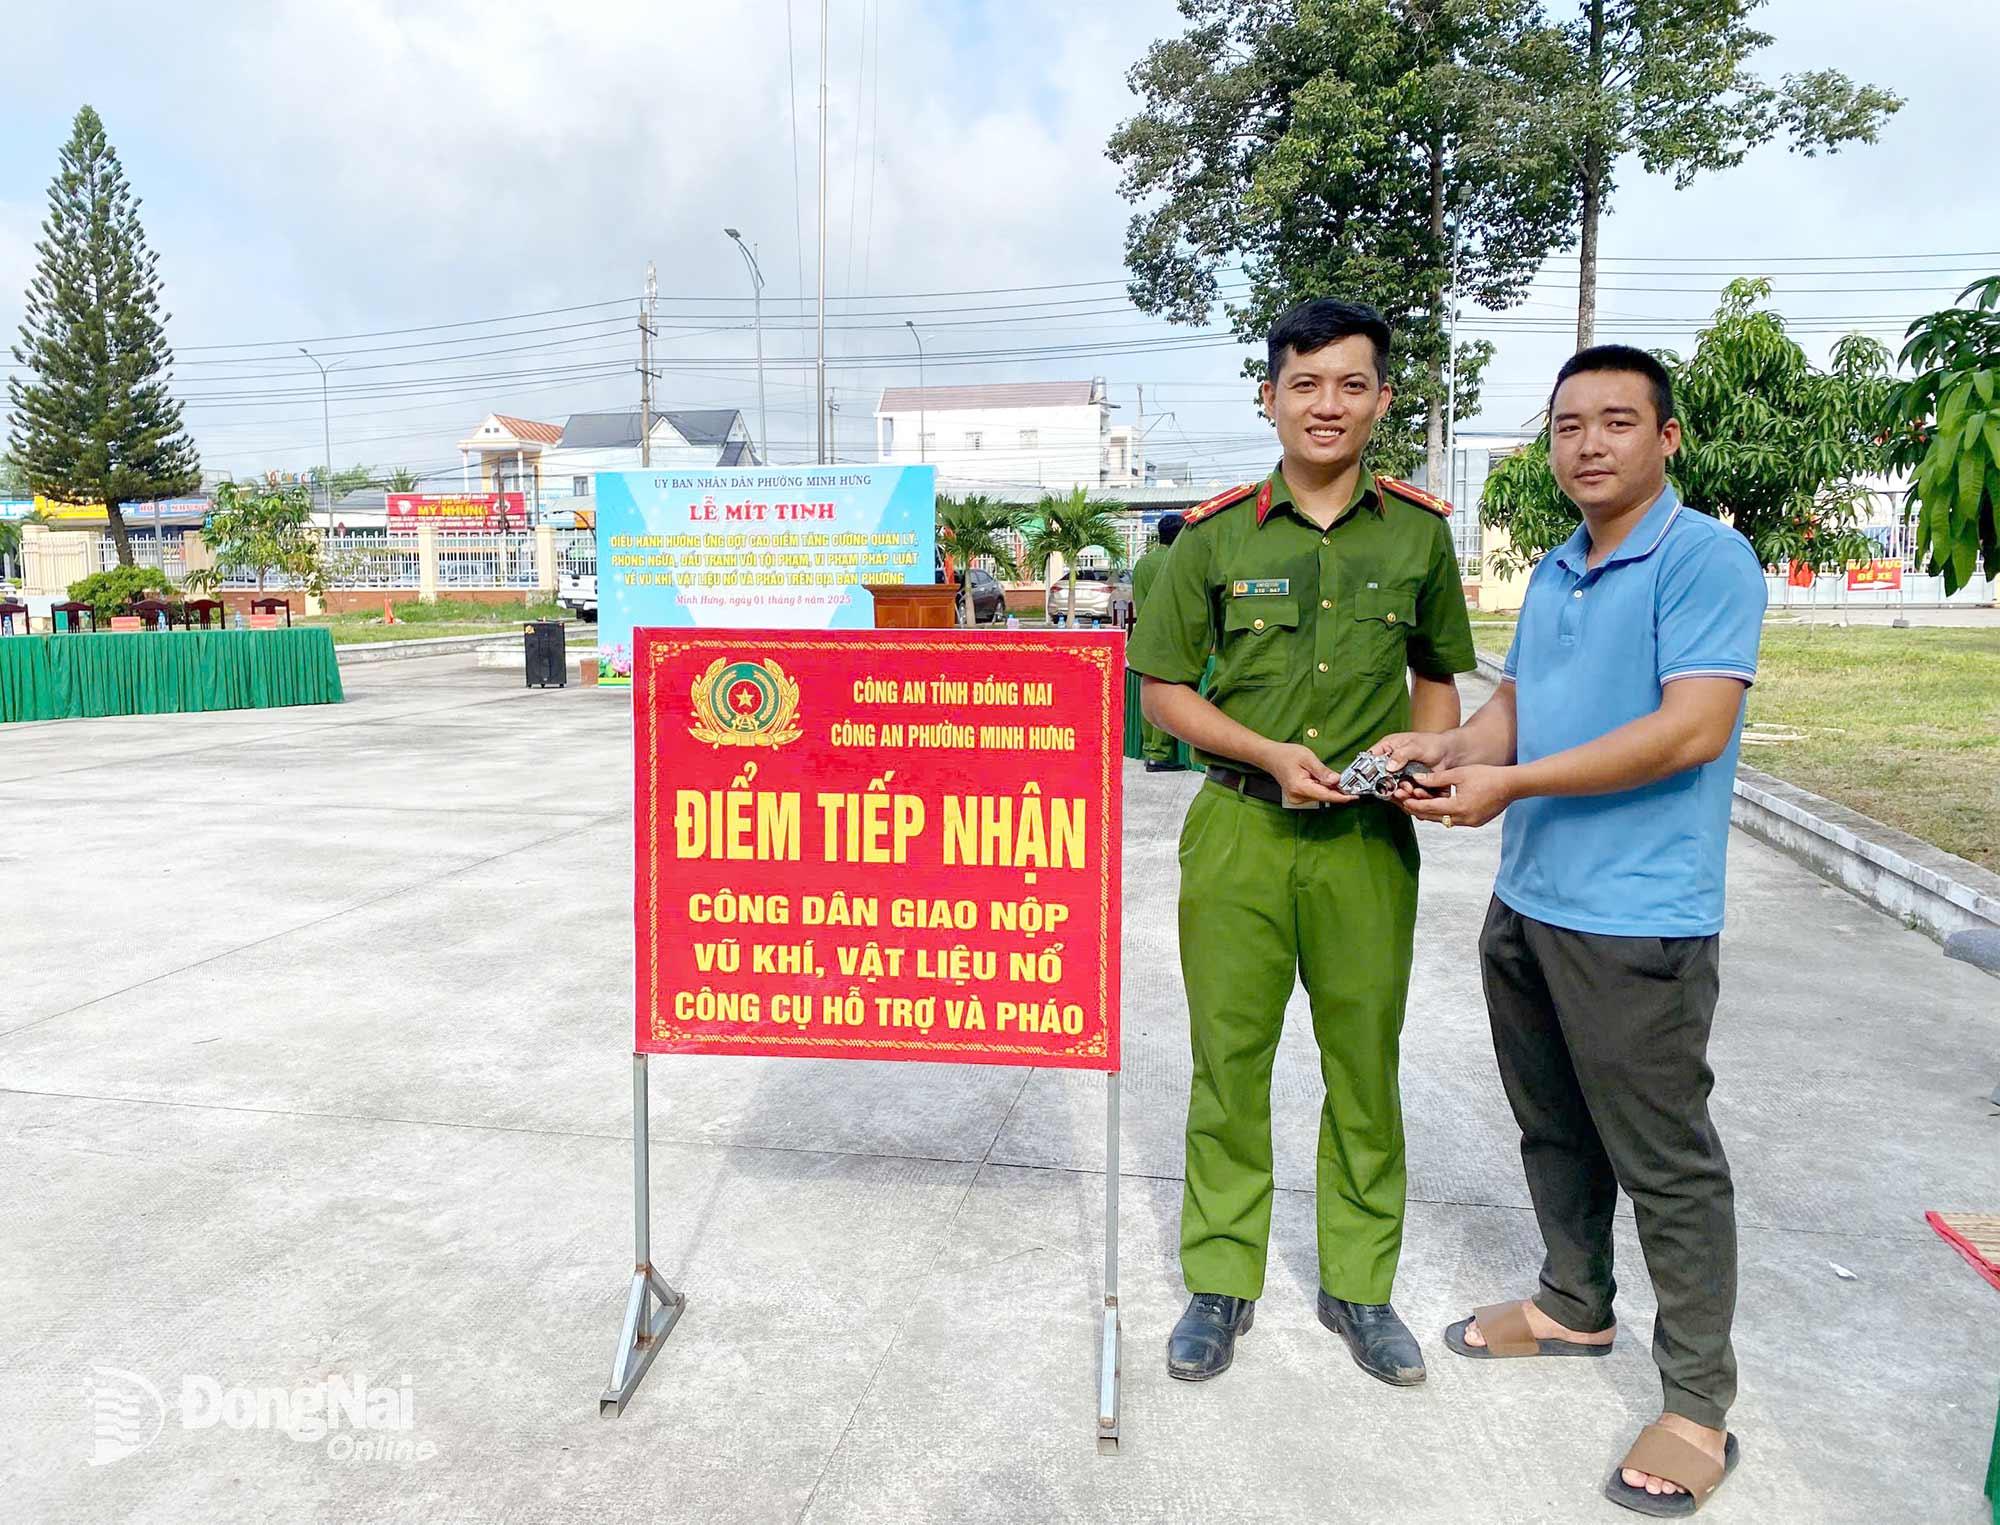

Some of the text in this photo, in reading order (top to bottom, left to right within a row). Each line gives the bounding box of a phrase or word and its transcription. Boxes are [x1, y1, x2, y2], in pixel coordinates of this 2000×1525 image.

[672, 478, 693, 489] BAN
[697, 475, 727, 488] NHÂN
[731, 476, 754, 488] DÂN
[757, 474, 803, 488] PHƯỜNG
[806, 475, 836, 487] MINH
[839, 474, 872, 486] HƯNG
[688, 495, 835, 521] LỄ MÍT TINH
[750, 534, 770, 547] CAO
[704, 554, 737, 566] TRANH
[740, 551, 757, 566] VỚI
[815, 553, 825, 566] VI
[828, 553, 858, 568] PHẠM
[861, 549, 889, 566] PHÁP
[892, 551, 919, 567] LUẬT
[677, 571, 696, 588] VẬT
[698, 570, 721, 588] LIỆU
[756, 570, 784, 585] PHÁO
[787, 571, 814, 585] TRÊN
[861, 568, 906, 584] PHƯỜNG
[676, 595, 698, 605] Minh
[728, 595, 752, 607] ngày
[753, 595, 764, 605] 01
[767, 594, 795, 607] tháng
[804, 595, 825, 605] năm
[827, 594, 852, 604] 2025
[853, 673, 1053, 707] CÔNG AN TỈNH ĐỒNG NAI
[831, 719, 1076, 751] CÔNG AN PHƯỜNG MINH HƯNG
[674, 760, 1087, 885] ĐIỂM TIẾP NHẬN
[688, 887, 1070, 938] CÔNG DÂN GIAO NỘP
[693, 938, 1065, 986] VŨ KHÍ, VẬT LIỆU NỔ
[674, 985, 1084, 1035] CÔNG CỤ HỖ TRỢ VÀ PHÁO
